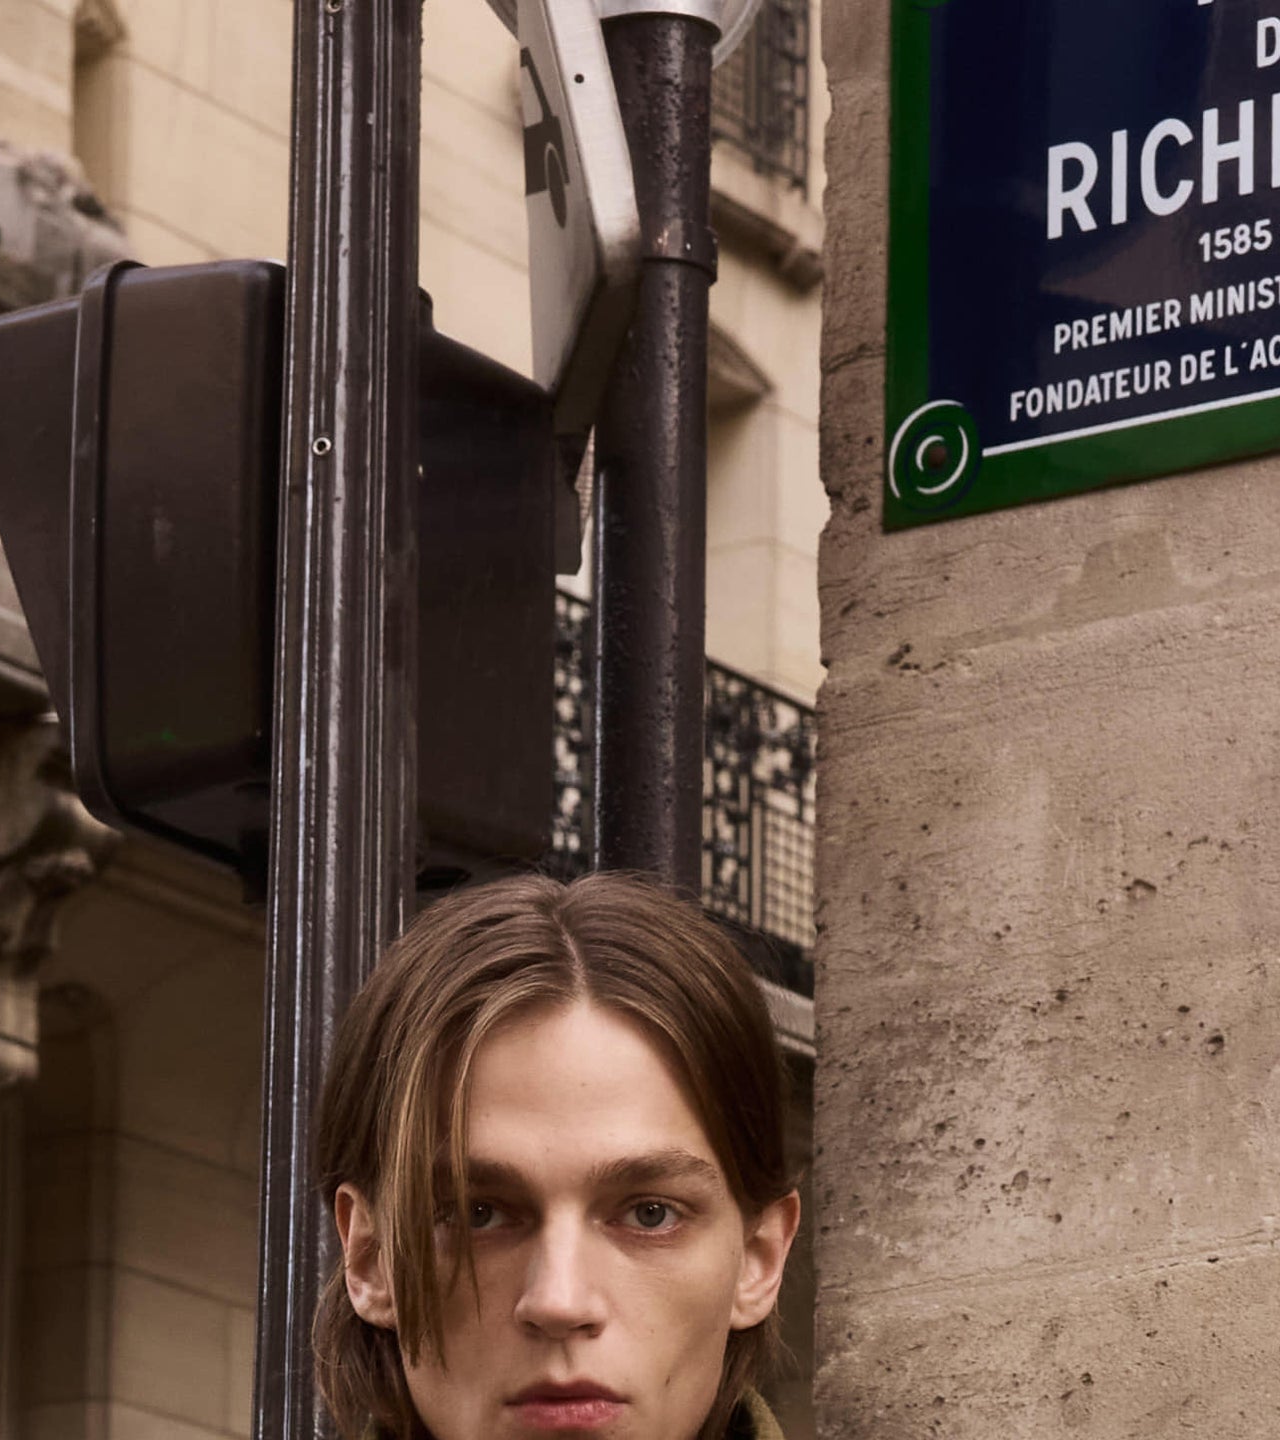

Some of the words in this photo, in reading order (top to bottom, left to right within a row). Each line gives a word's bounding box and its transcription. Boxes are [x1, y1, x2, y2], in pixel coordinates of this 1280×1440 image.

[1198, 218, 1273, 263] 1585
[1053, 299, 1181, 354] PREMIER
[1009, 360, 1172, 422] FONDATEUR
[1179, 349, 1217, 386] DE
